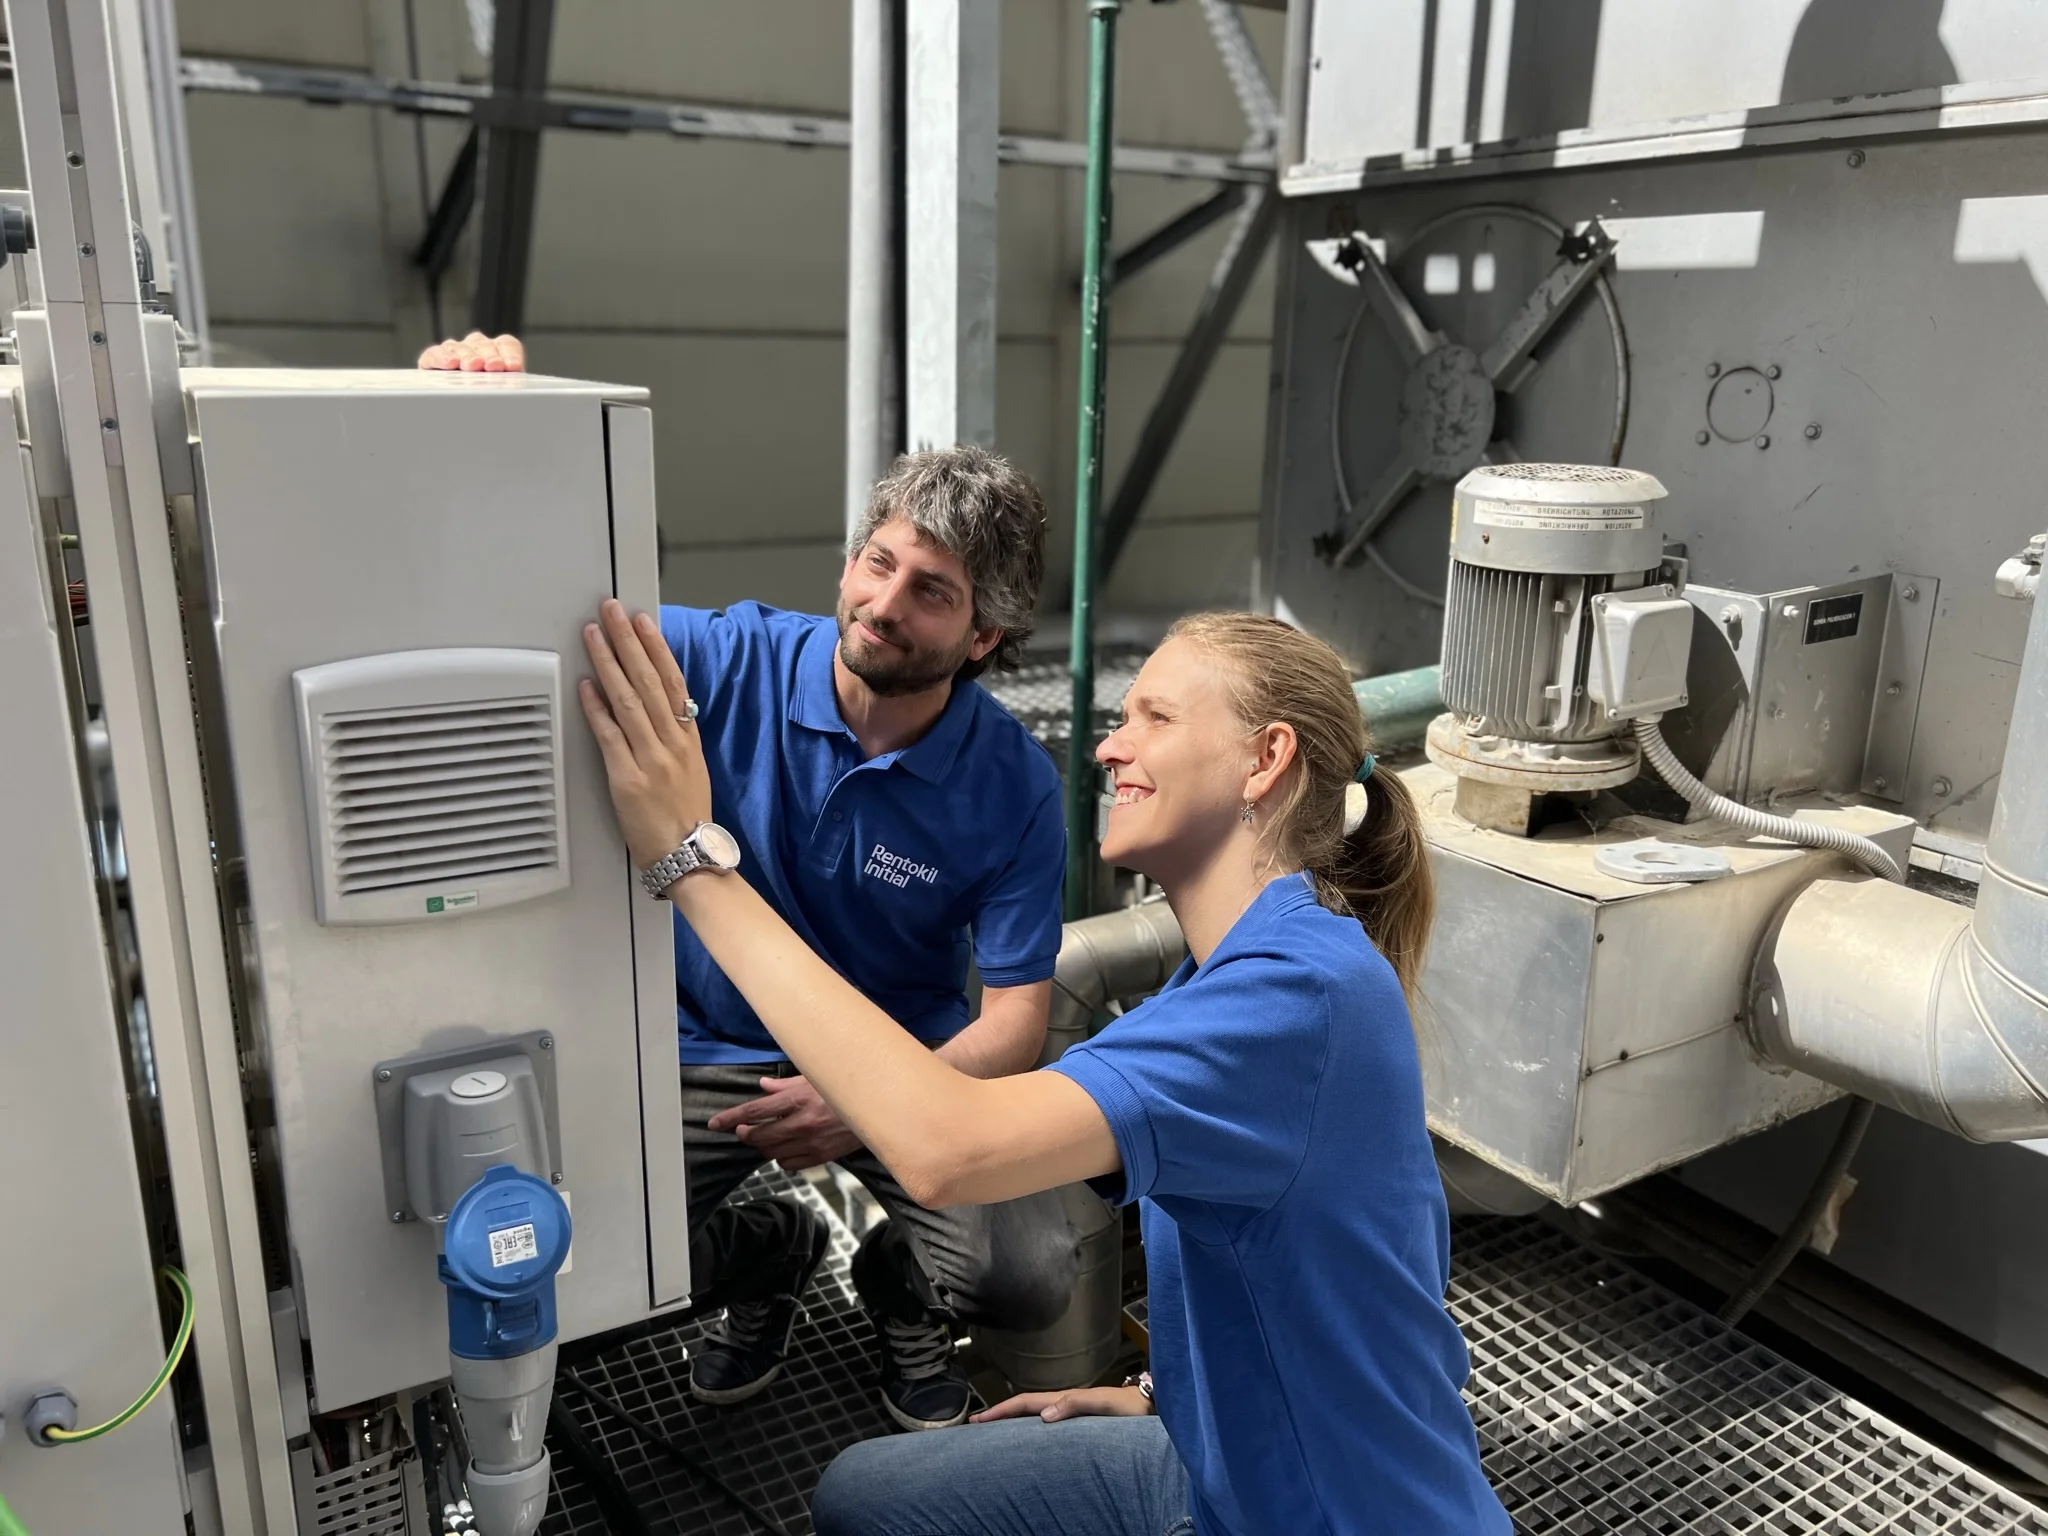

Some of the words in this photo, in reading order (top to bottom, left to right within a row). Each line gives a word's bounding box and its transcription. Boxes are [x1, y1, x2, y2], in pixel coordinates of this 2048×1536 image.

[1537, 507, 1591, 516] DREHRICHTUNG
[1602, 508, 1635, 516] ROTAZIONE
[1538, 521, 1589, 530] DREHRICHTUNG
[1604, 522, 1632, 530] ROTATION
[871, 844, 939, 884] Rentokil
[864, 858, 911, 889] Initial
